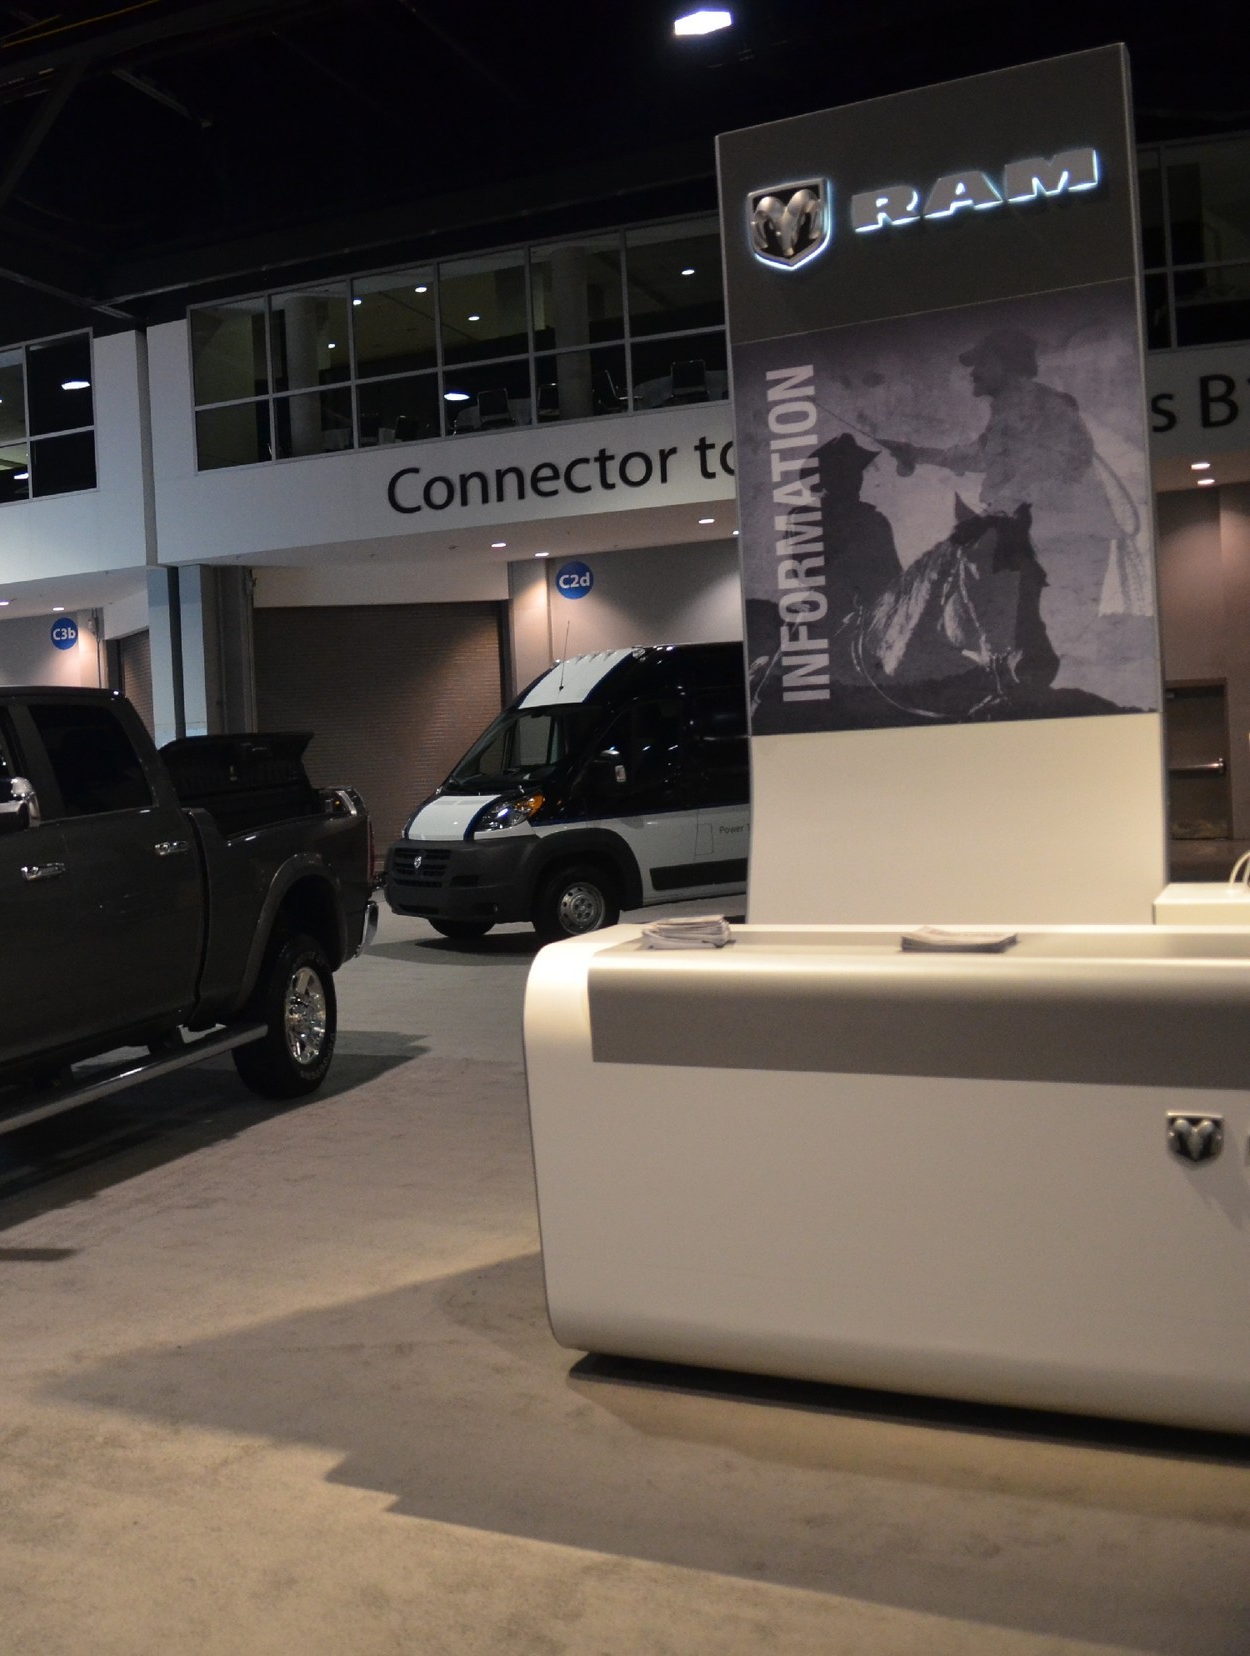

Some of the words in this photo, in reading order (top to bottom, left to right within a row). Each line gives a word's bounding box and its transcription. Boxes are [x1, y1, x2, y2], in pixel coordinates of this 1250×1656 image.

[851, 147, 1099, 234] RAM
[1200, 374, 1250, 429] B
[387, 446, 678, 514] Connector
[766, 364, 831, 702] INFORMATION
[559, 572, 590, 588] C2d
[53, 627, 76, 640] C3b
[719, 825, 744, 834] Power
